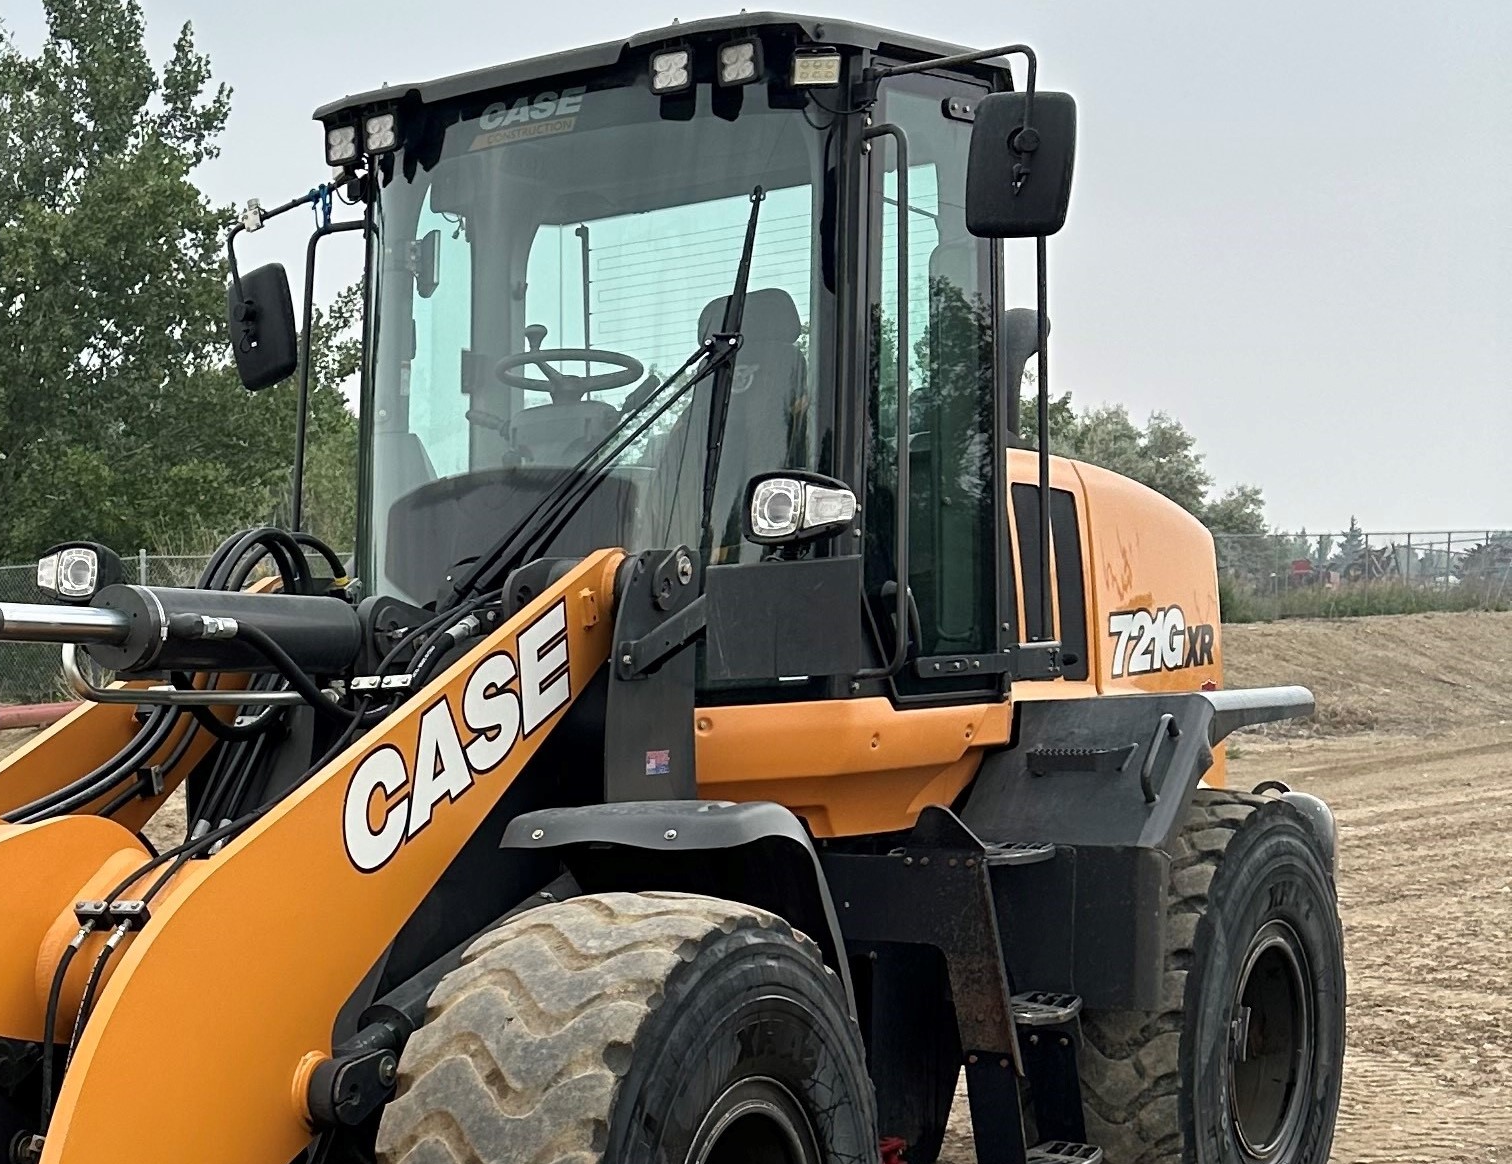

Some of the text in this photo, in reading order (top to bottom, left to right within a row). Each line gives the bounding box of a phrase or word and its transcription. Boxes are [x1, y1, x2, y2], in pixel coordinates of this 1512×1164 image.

[479, 86, 586, 130] CASE
[487, 119, 573, 144] CONSTRUCTION
[1108, 604, 1214, 679] 721G XR
[342, 597, 572, 873] CASE
